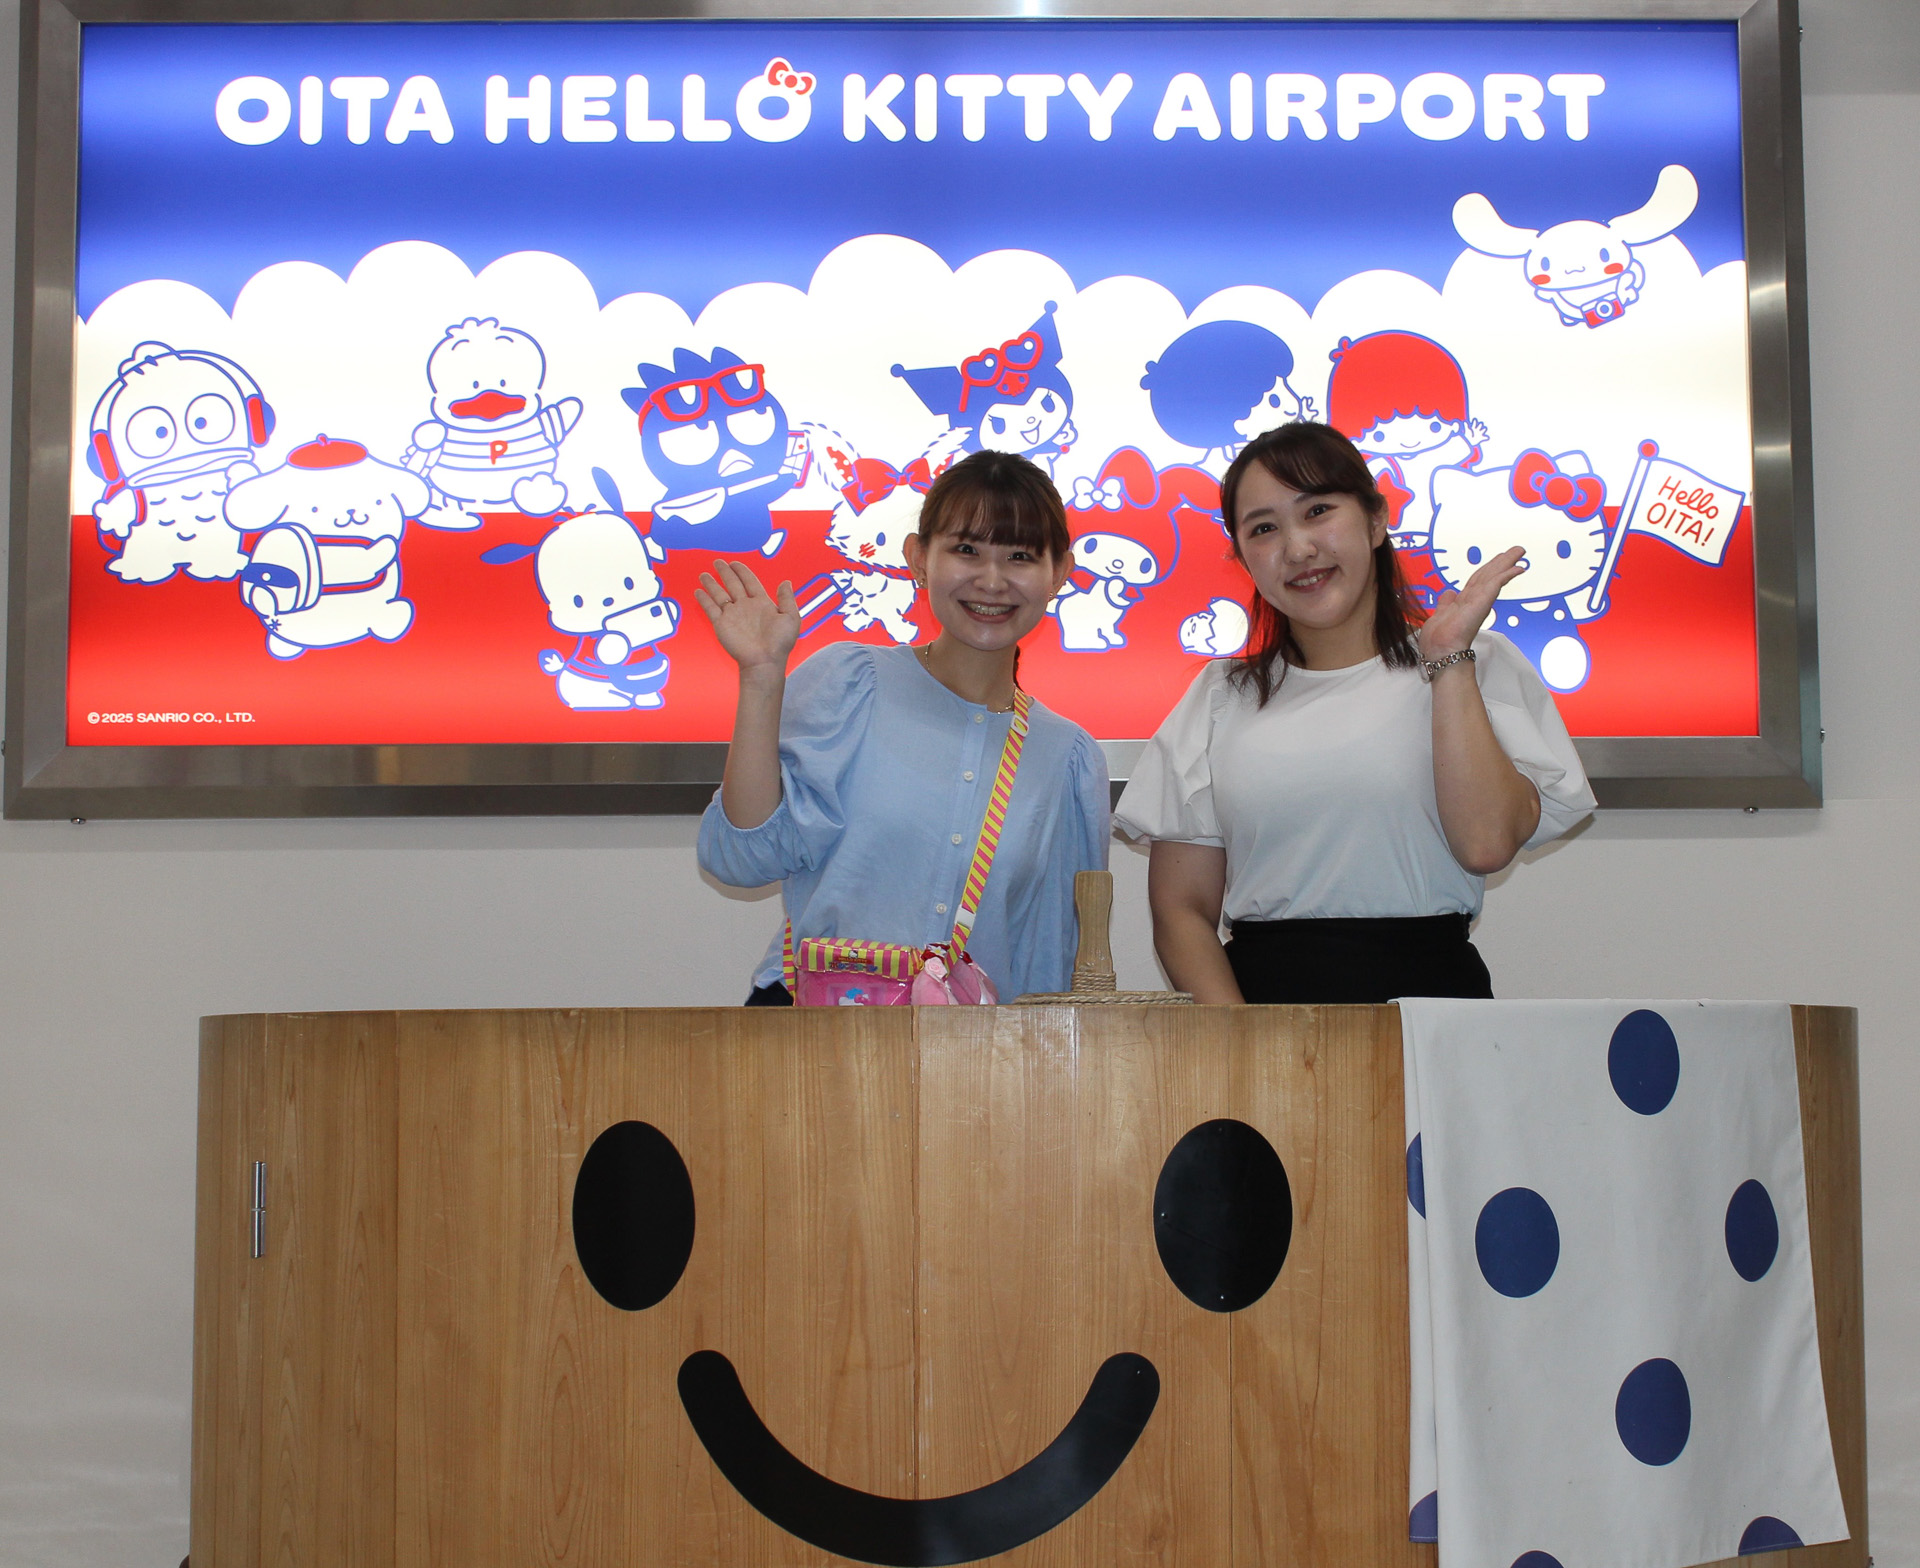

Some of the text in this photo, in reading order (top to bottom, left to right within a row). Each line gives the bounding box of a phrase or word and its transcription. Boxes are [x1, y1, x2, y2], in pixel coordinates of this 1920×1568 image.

[215, 71, 1605, 145] OITA HELLO KITTY AIRPORT
[490, 440, 508, 465] P
[1658, 475, 1719, 520] Hello
[1646, 502, 1715, 547] OITA!
[136, 711, 190, 723] SANRIO
[192, 711, 222, 724] CO.,
[225, 711, 256, 723] LTD.
